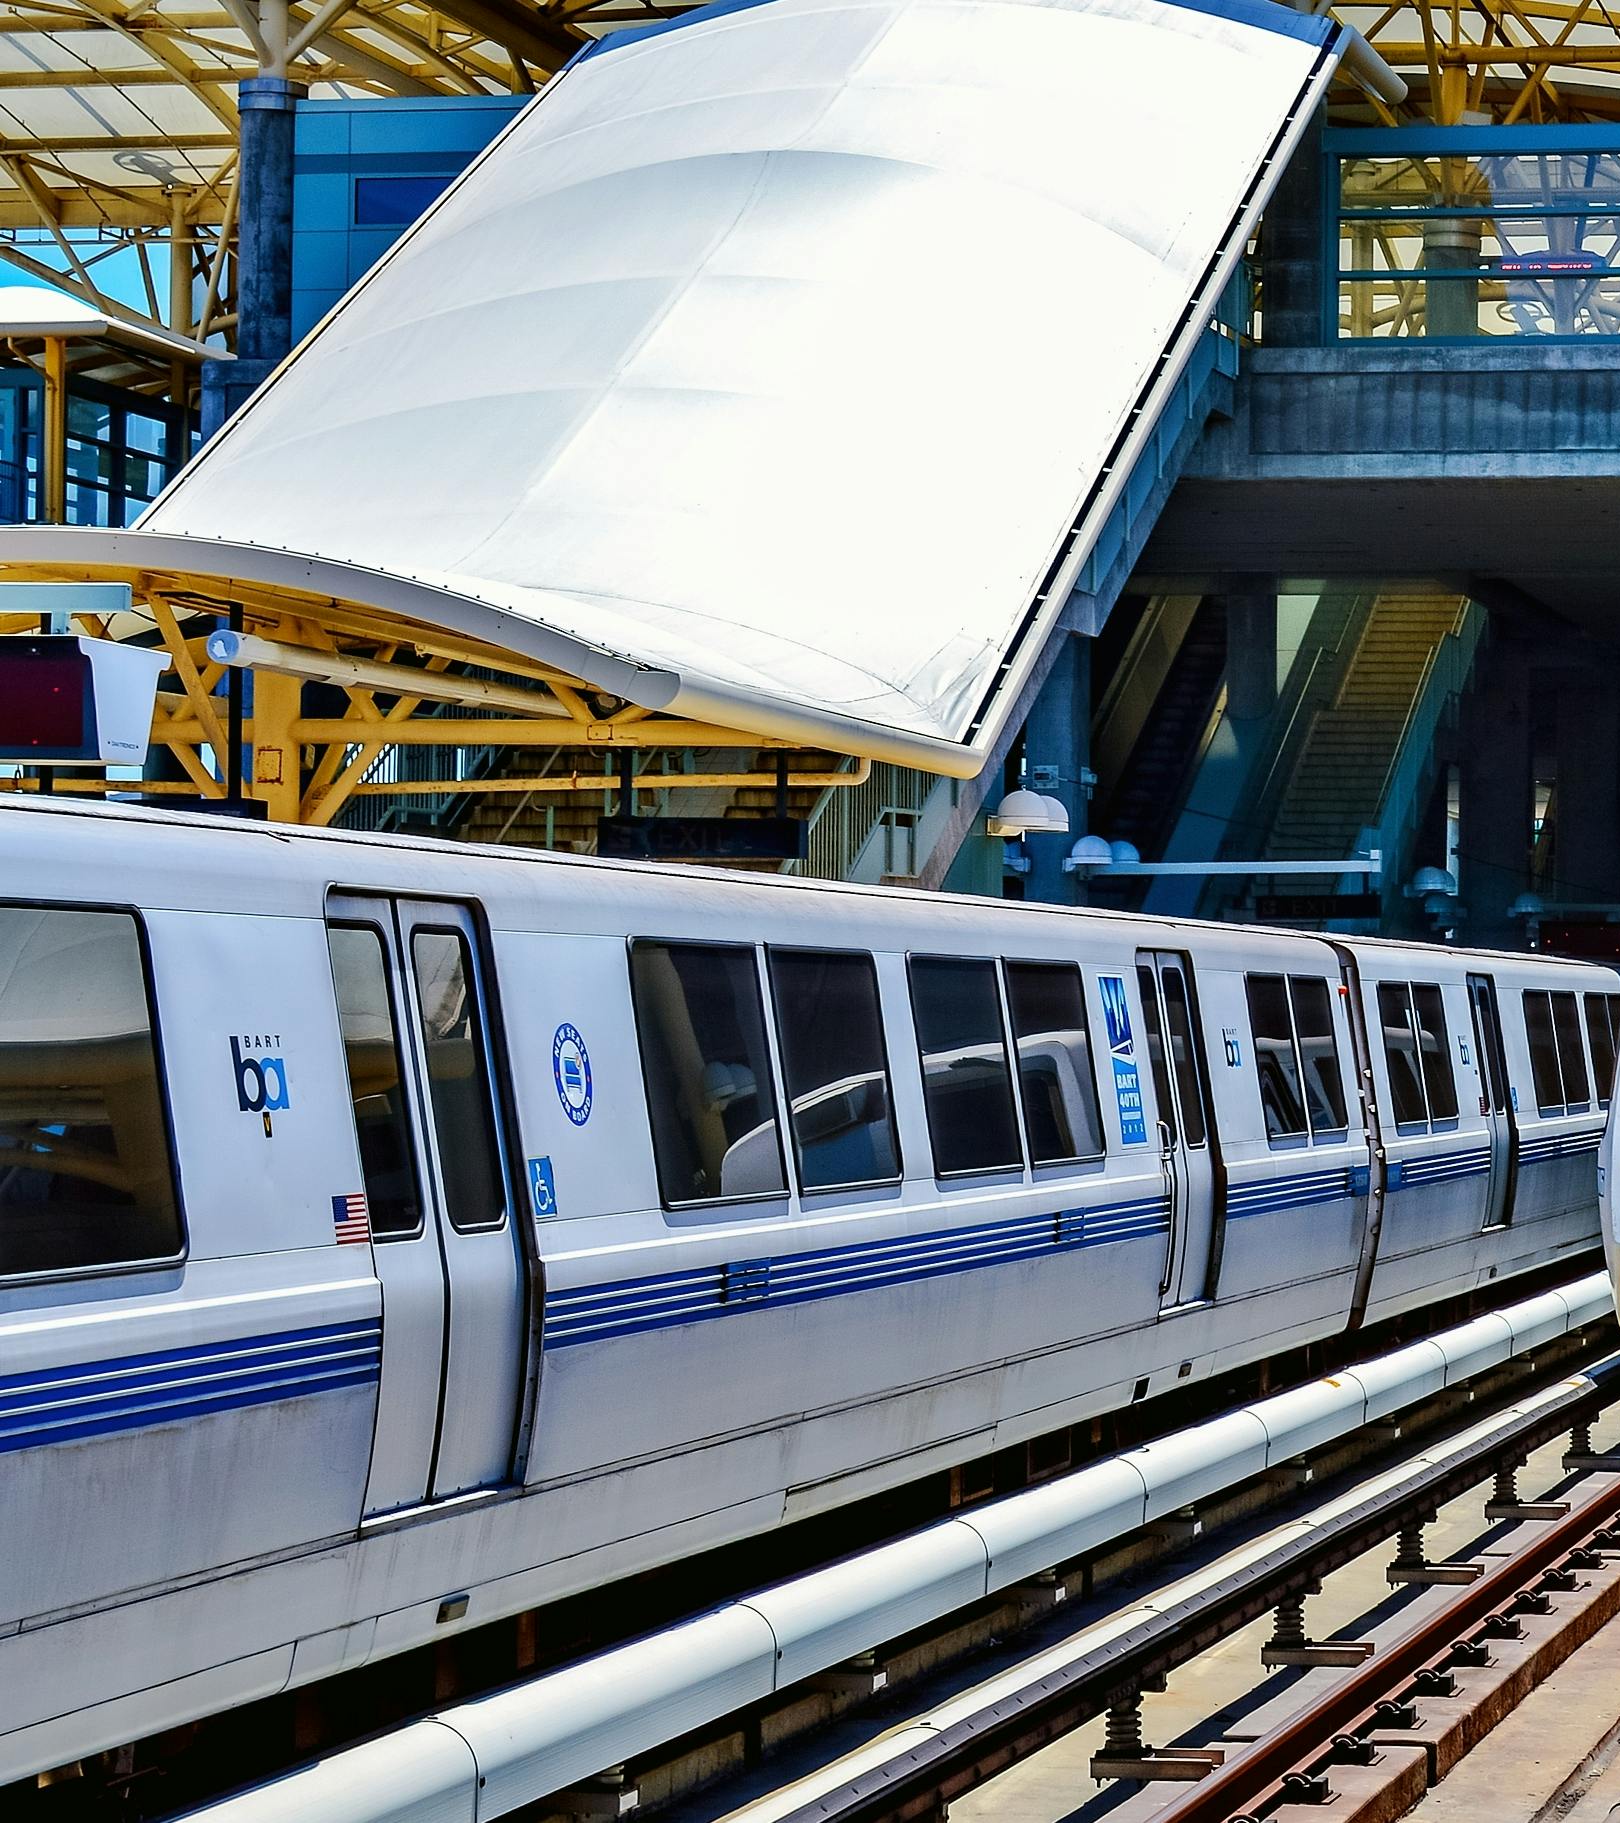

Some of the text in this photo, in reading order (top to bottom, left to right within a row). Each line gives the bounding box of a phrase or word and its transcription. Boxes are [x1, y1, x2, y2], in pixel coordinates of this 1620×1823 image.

[243, 1034, 281, 1048] BART
[1116, 1073, 1137, 1090] BART
[1119, 1092, 1141, 1108] 40TH
